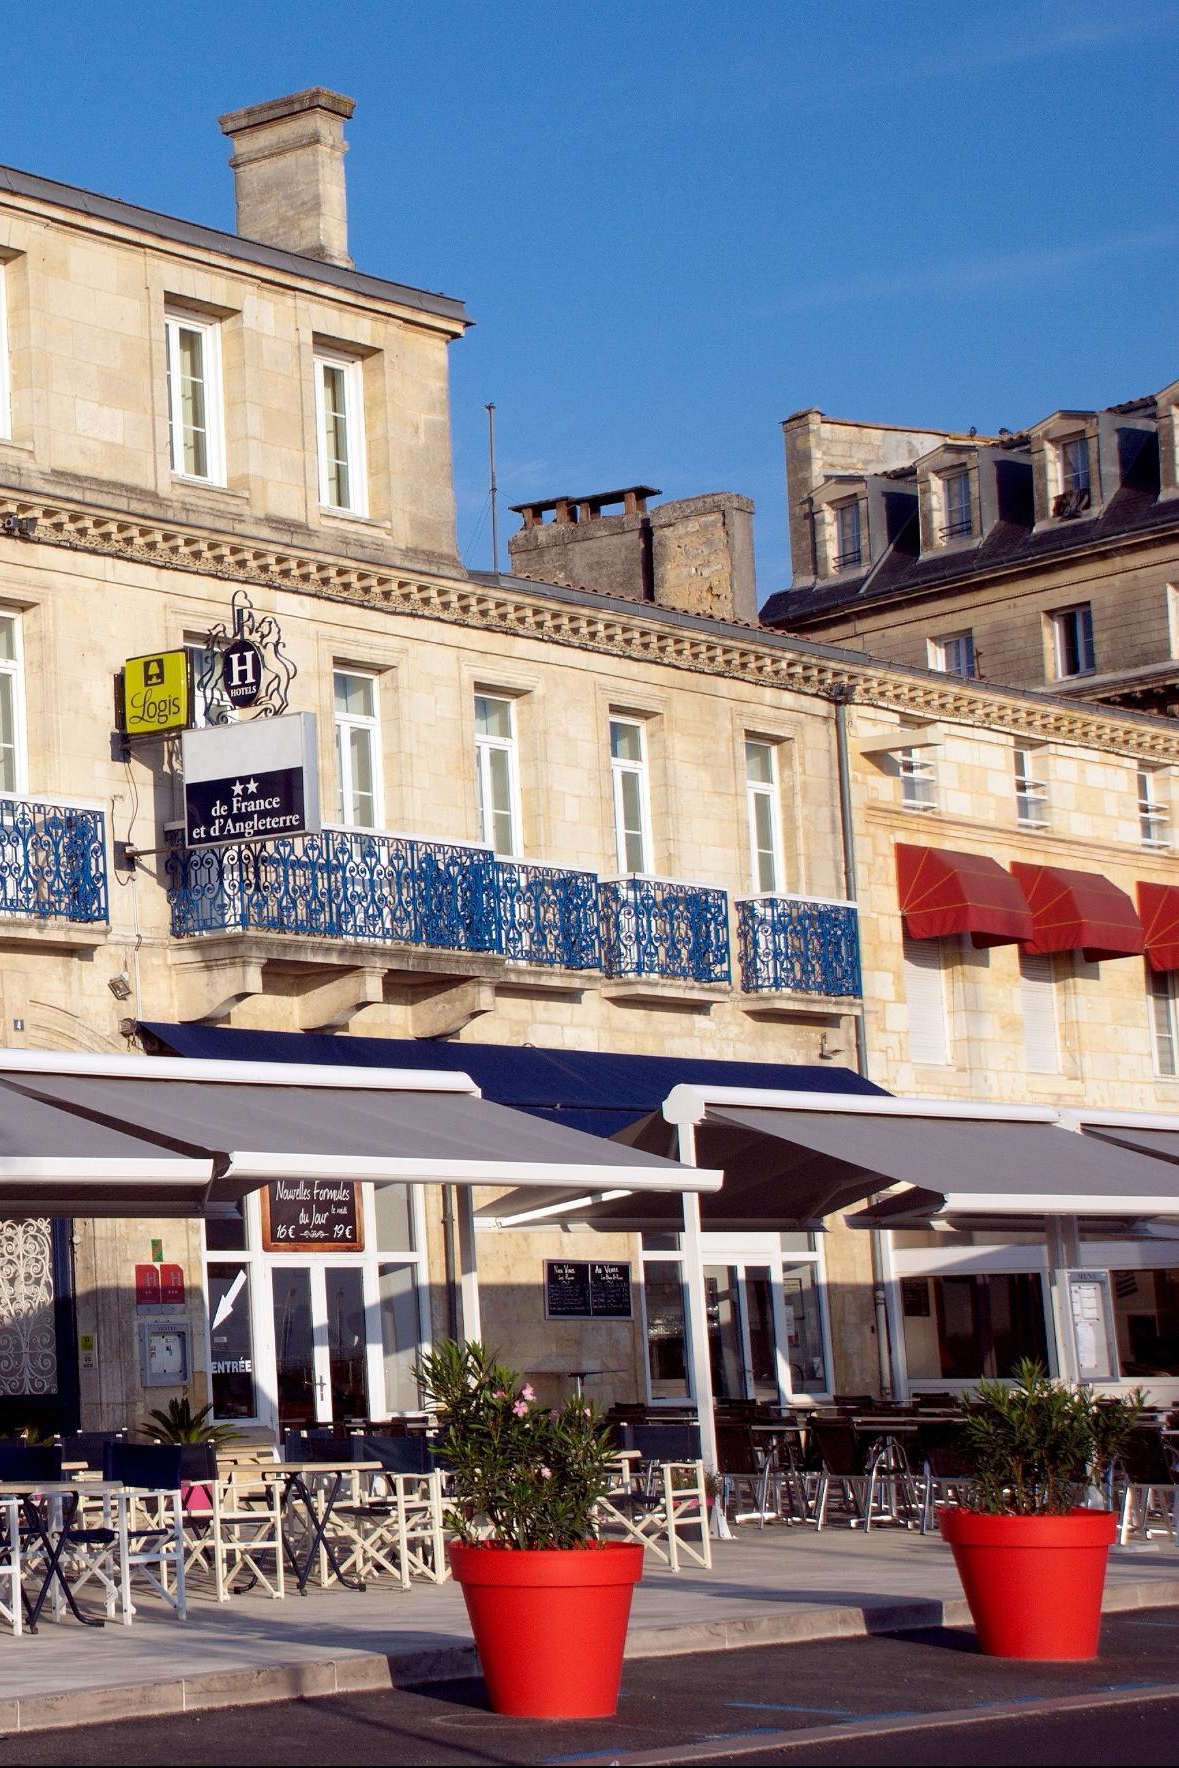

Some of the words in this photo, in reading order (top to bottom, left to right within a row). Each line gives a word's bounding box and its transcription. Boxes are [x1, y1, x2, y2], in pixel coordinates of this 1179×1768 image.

[230, 651, 255, 686] H
[230, 685, 257, 697] HOTELS
[129, 688, 181, 724] Logis
[211, 800, 228, 817] de
[232, 795, 280, 814] France
[192, 824, 206, 839] et
[210, 814, 300, 837] d'Angleterre
[275, 1180, 311, 1201] Nouvelles
[313, 1180, 351, 1201] Formules
[298, 1208, 309, 1225] du
[310, 1204, 329, 1228] Jour
[211, 1356, 252, 1374] ENTRÉE
